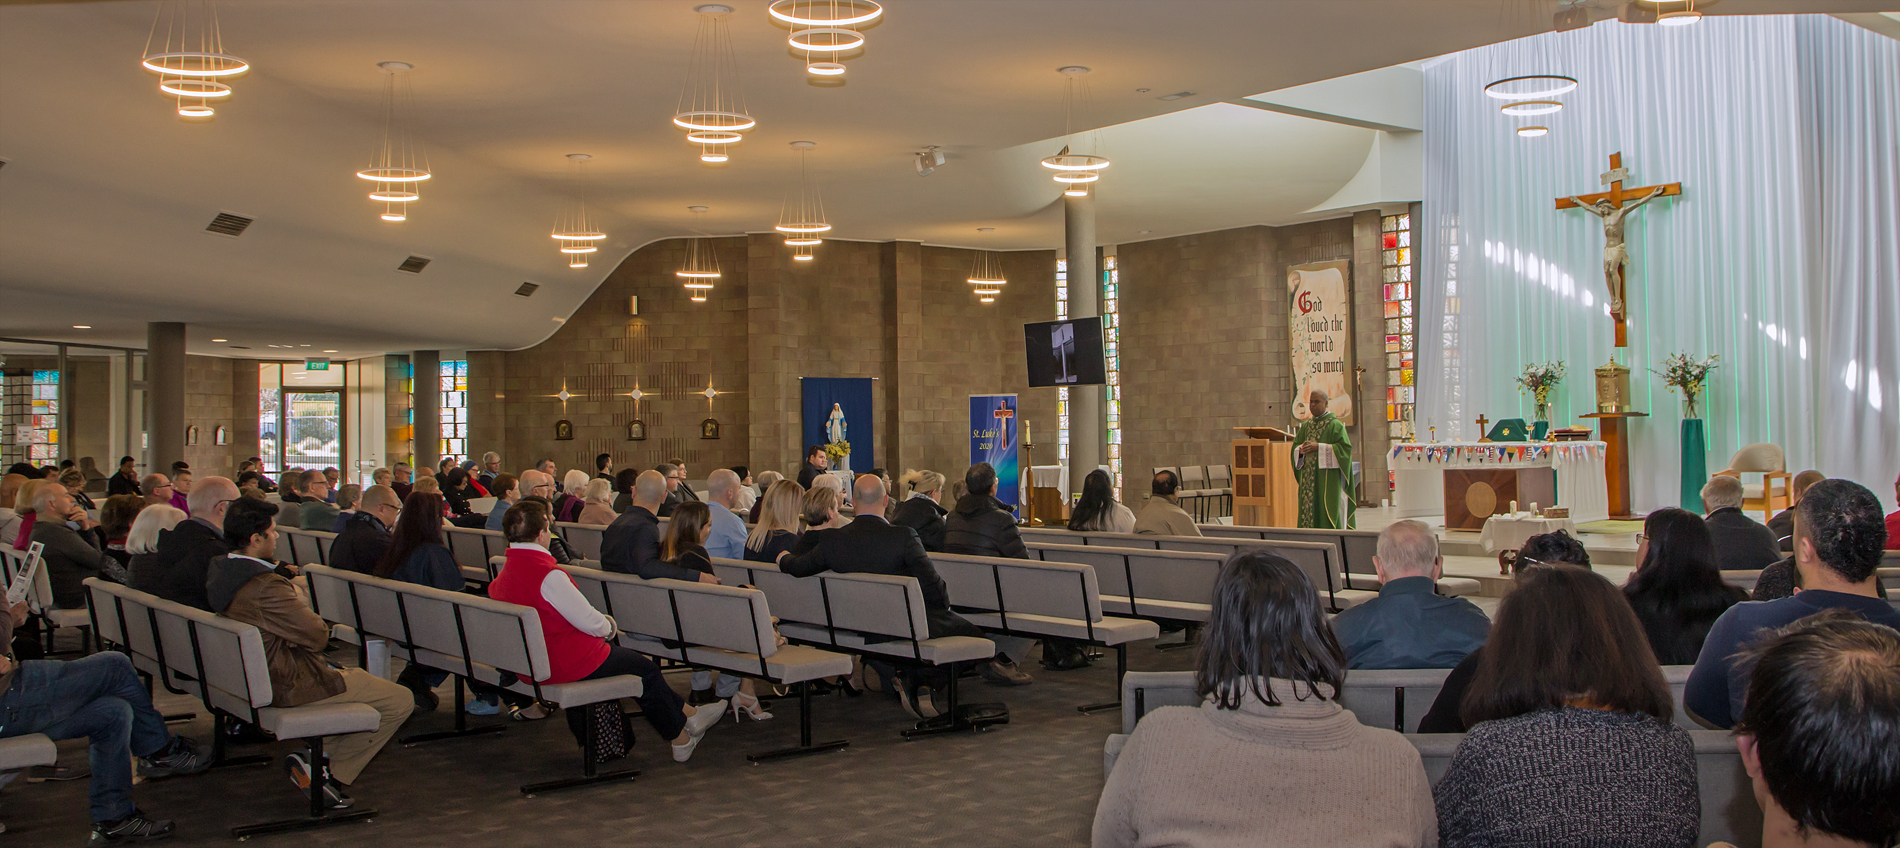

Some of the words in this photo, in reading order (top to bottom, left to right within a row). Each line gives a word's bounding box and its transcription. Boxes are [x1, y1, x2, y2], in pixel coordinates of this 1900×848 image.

[1298, 290, 1322, 315] God
[1331, 314, 1343, 332] the
[1310, 335, 1334, 352] world
[1312, 361, 1322, 374] so
[1323, 357, 1344, 373] much
[972, 429, 980, 438] St.
[981, 428, 999, 438] Luke's
[979, 442, 993, 450] 2020
